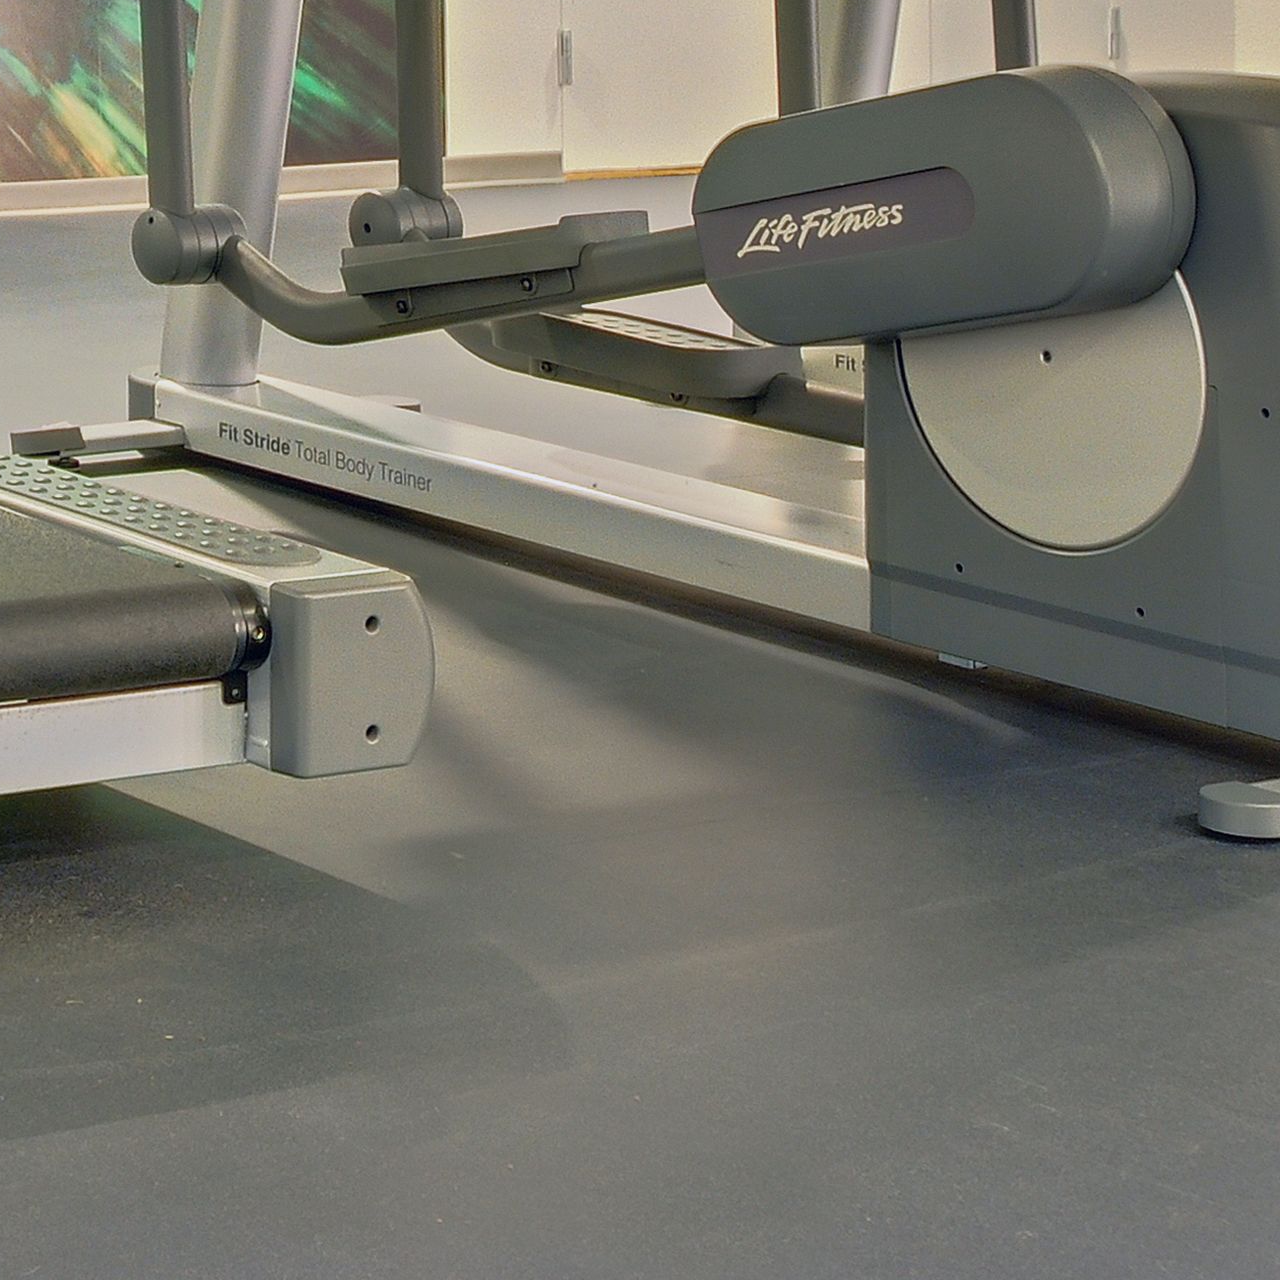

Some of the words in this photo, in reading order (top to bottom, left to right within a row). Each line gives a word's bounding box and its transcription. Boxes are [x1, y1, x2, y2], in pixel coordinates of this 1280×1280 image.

[834, 354, 857, 372] Fit
[218, 422, 238, 443] Fit
[243, 428, 291, 456] Stride
[294, 440, 331, 467] Total
[335, 450, 375, 481] Body
[378, 462, 432, 493] Trainer
